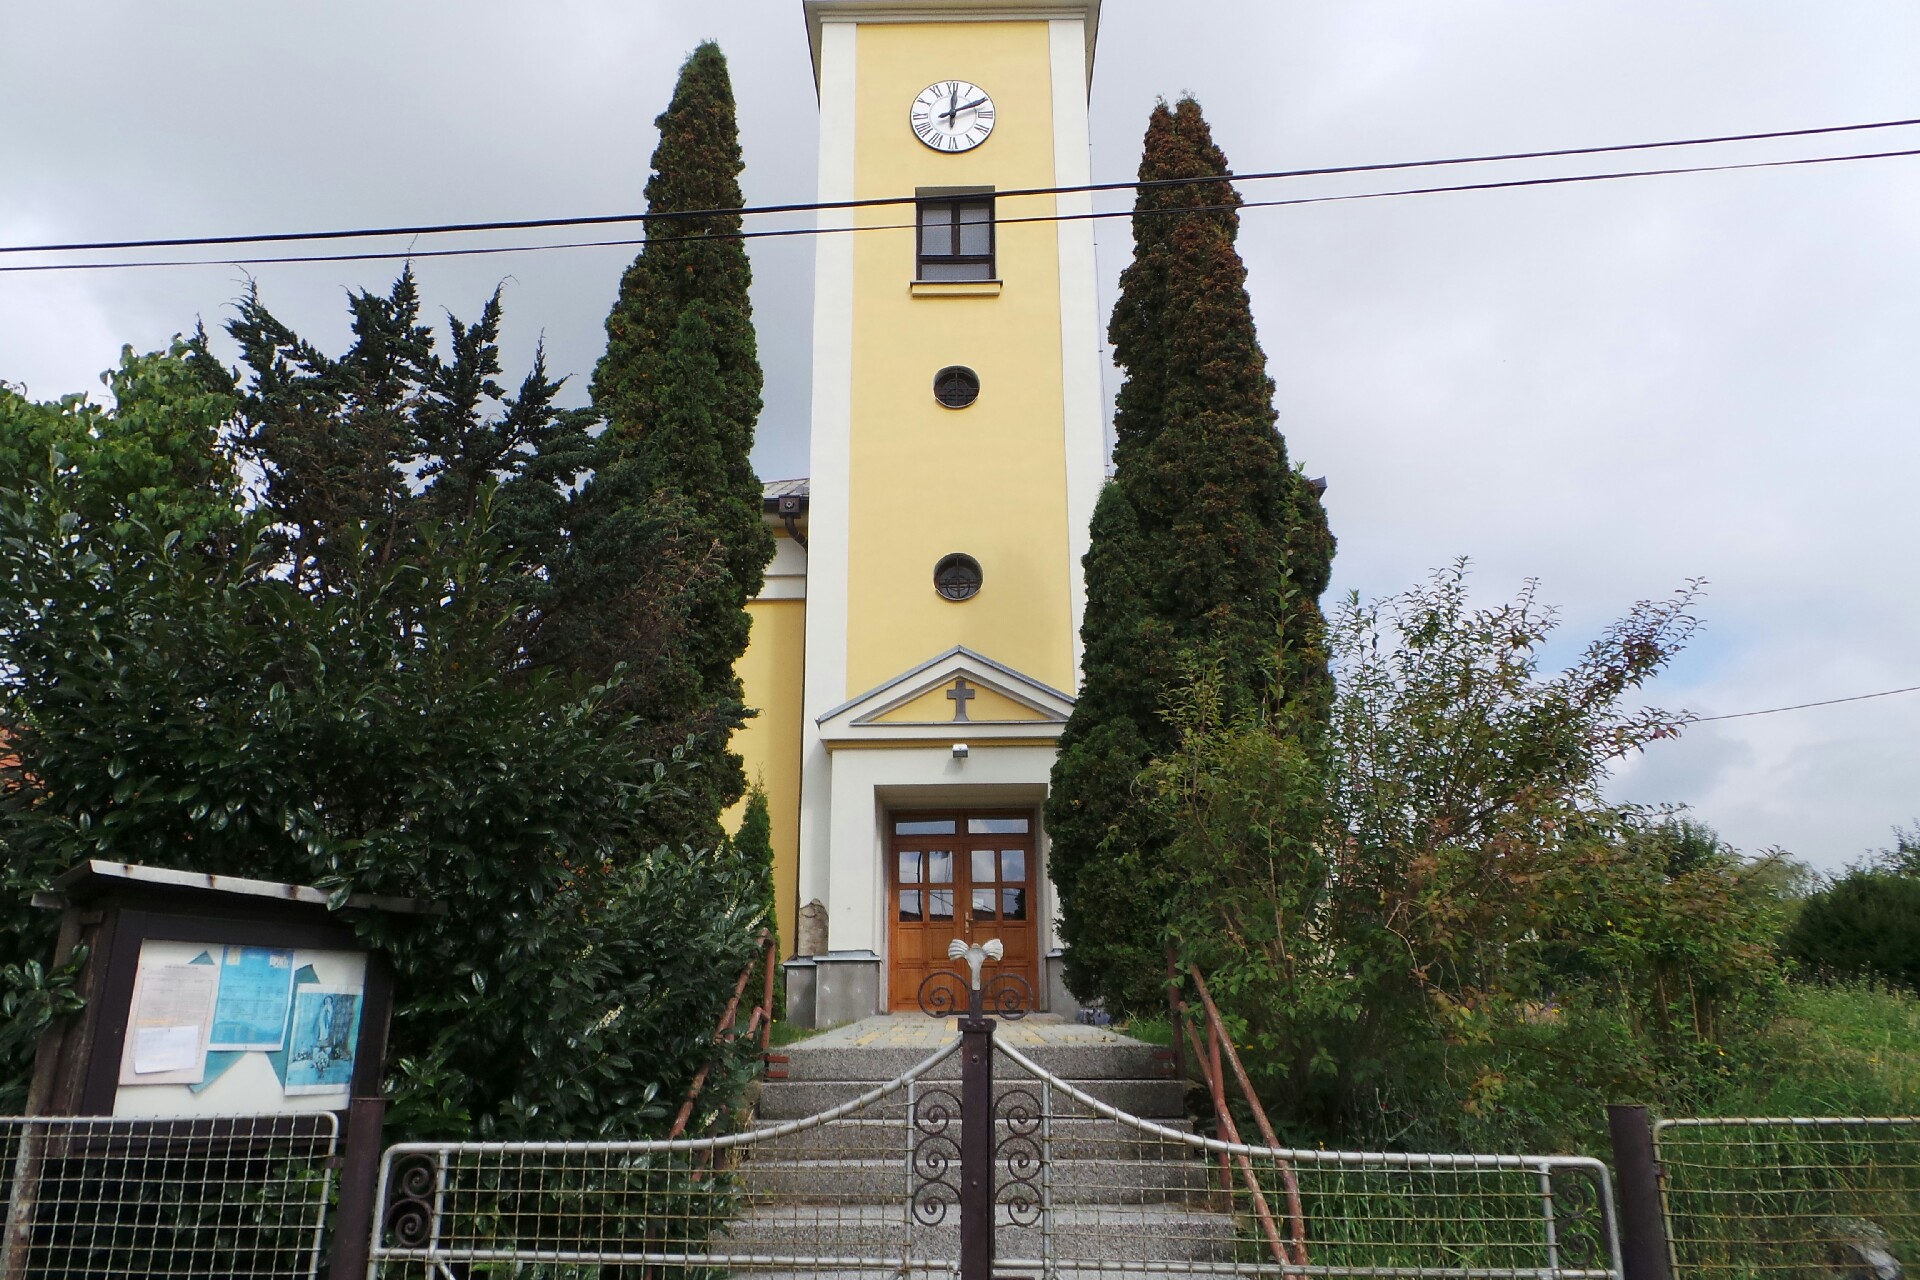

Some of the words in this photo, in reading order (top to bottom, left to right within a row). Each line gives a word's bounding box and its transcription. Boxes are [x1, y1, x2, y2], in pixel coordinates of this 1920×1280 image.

[929, 85, 943, 98] XI
[965, 86, 974, 97] I
[916, 97, 932, 107] X
[912, 111, 928, 120] IX
[978, 110, 993, 120] III
[914, 121, 933, 138] VIII
[974, 123, 990, 135] IV
[928, 132, 944, 148] VII
[948, 136, 959, 150] VI
[965, 133, 976, 146] V
